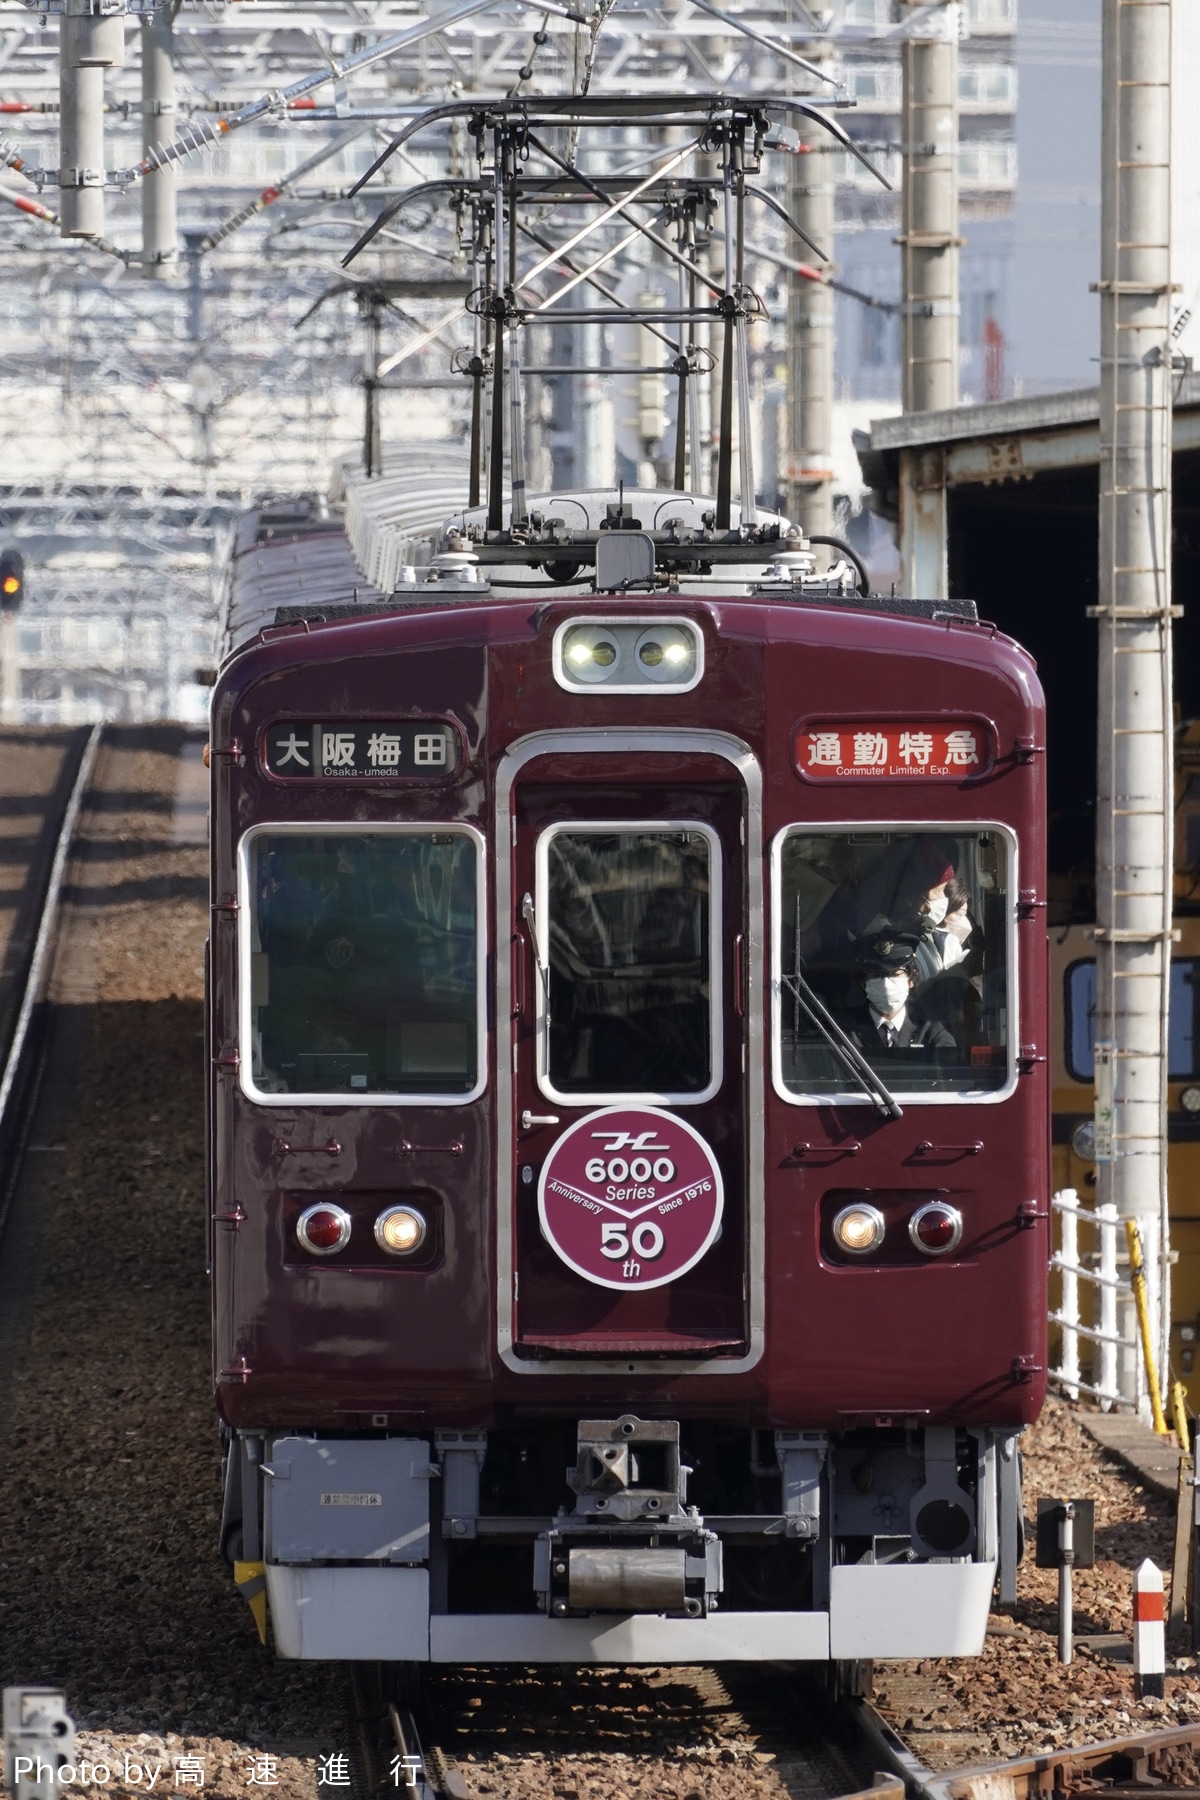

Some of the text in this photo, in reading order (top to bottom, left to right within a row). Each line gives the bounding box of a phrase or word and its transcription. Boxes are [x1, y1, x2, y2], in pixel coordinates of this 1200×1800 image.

[276, 733, 446, 767] 大阪梅田
[808, 731, 979, 766] 通勤特急
[324, 767, 399, 777] Osaka-umeda
[836, 765, 951, 776] Commuter Limited Exp.
[585, 1157, 676, 1183] 6000
[547, 1181, 604, 1215] Anniversary
[605, 1184, 656, 1201] Series
[658, 1181, 712, 1215] Since 1976
[600, 1221, 665, 1259] 50
[622, 1259, 641, 1278] th
